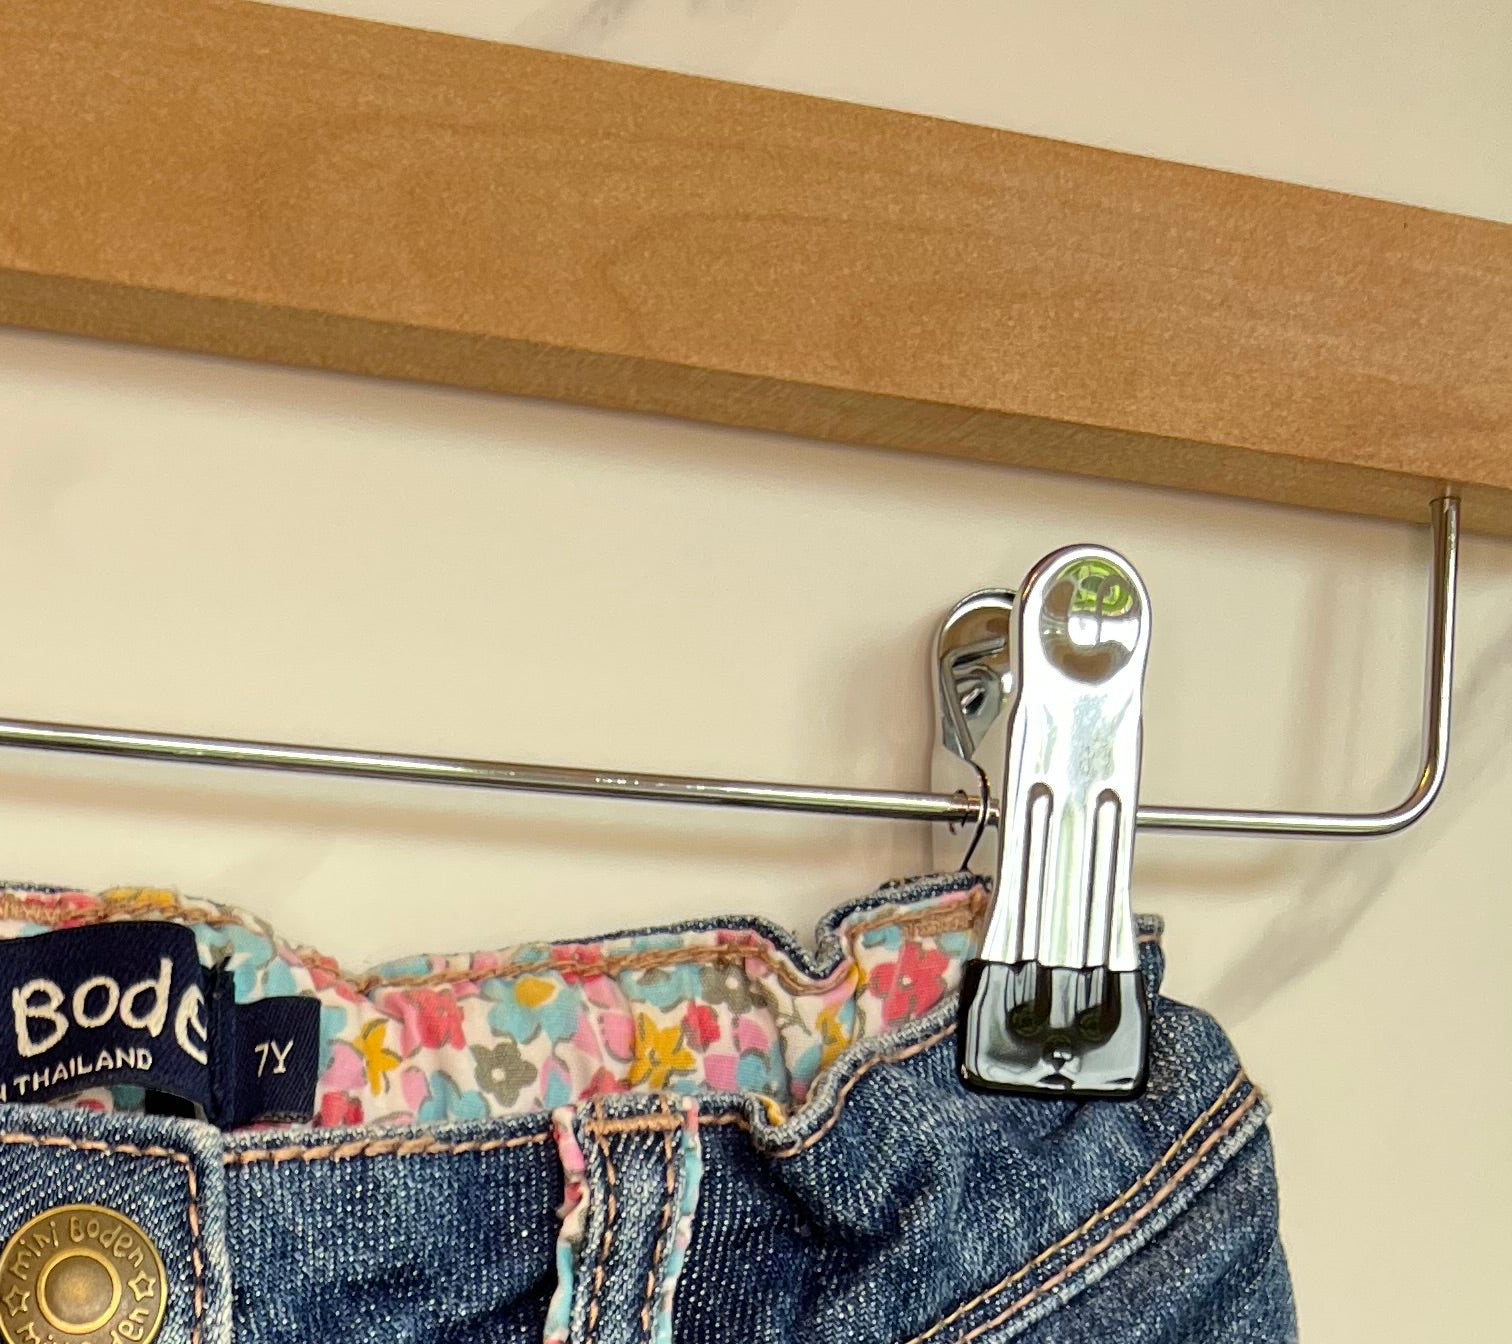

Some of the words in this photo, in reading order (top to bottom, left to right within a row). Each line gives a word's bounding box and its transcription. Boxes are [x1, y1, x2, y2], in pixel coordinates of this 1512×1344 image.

[13, 1046, 154, 1096] THAILAND
[254, 1039, 294, 1079] 7Y
[8, 1220, 59, 1281] mini
[69, 1215, 144, 1269] Boden
